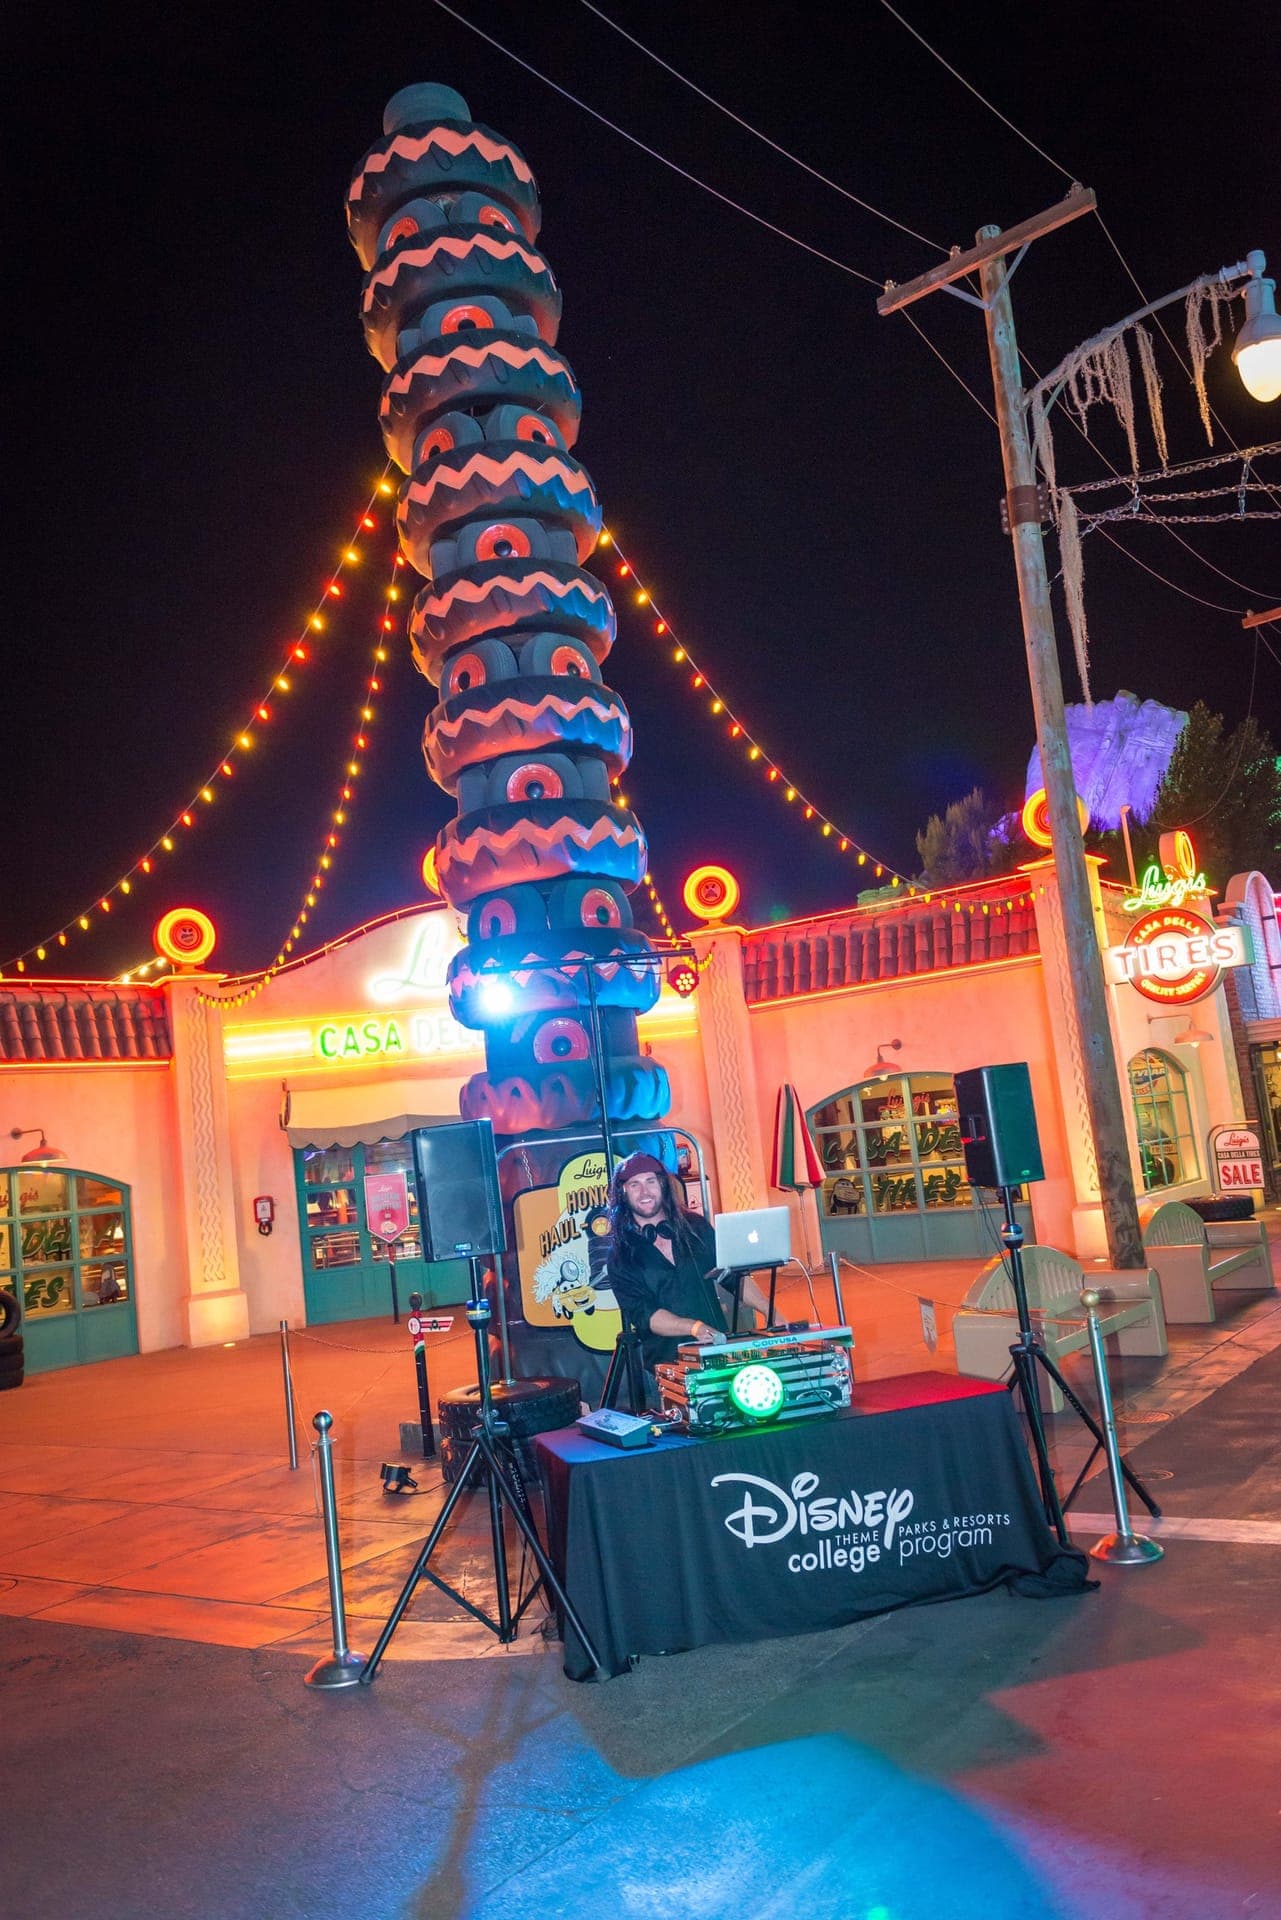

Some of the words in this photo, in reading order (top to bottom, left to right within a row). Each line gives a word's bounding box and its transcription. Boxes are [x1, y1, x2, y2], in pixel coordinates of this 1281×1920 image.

[1134, 920, 1161, 944] CASA
[1163, 917, 1201, 935] DELLA
[1113, 934, 1237, 979] TIRES
[319, 1019, 402, 1058] CASA
[573, 1159, 607, 1180] Luigi
[1221, 1164, 1262, 1185] SALE
[566, 1184, 608, 1215] HONK
[710, 1471, 914, 1549] Disney
[835, 1529, 879, 1547] THEME
[899, 1520, 937, 1537] PARKS
[942, 1517, 950, 1529] &
[953, 1513, 1011, 1528] RESORTS
[788, 1540, 881, 1573] college
[900, 1527, 992, 1567] program
